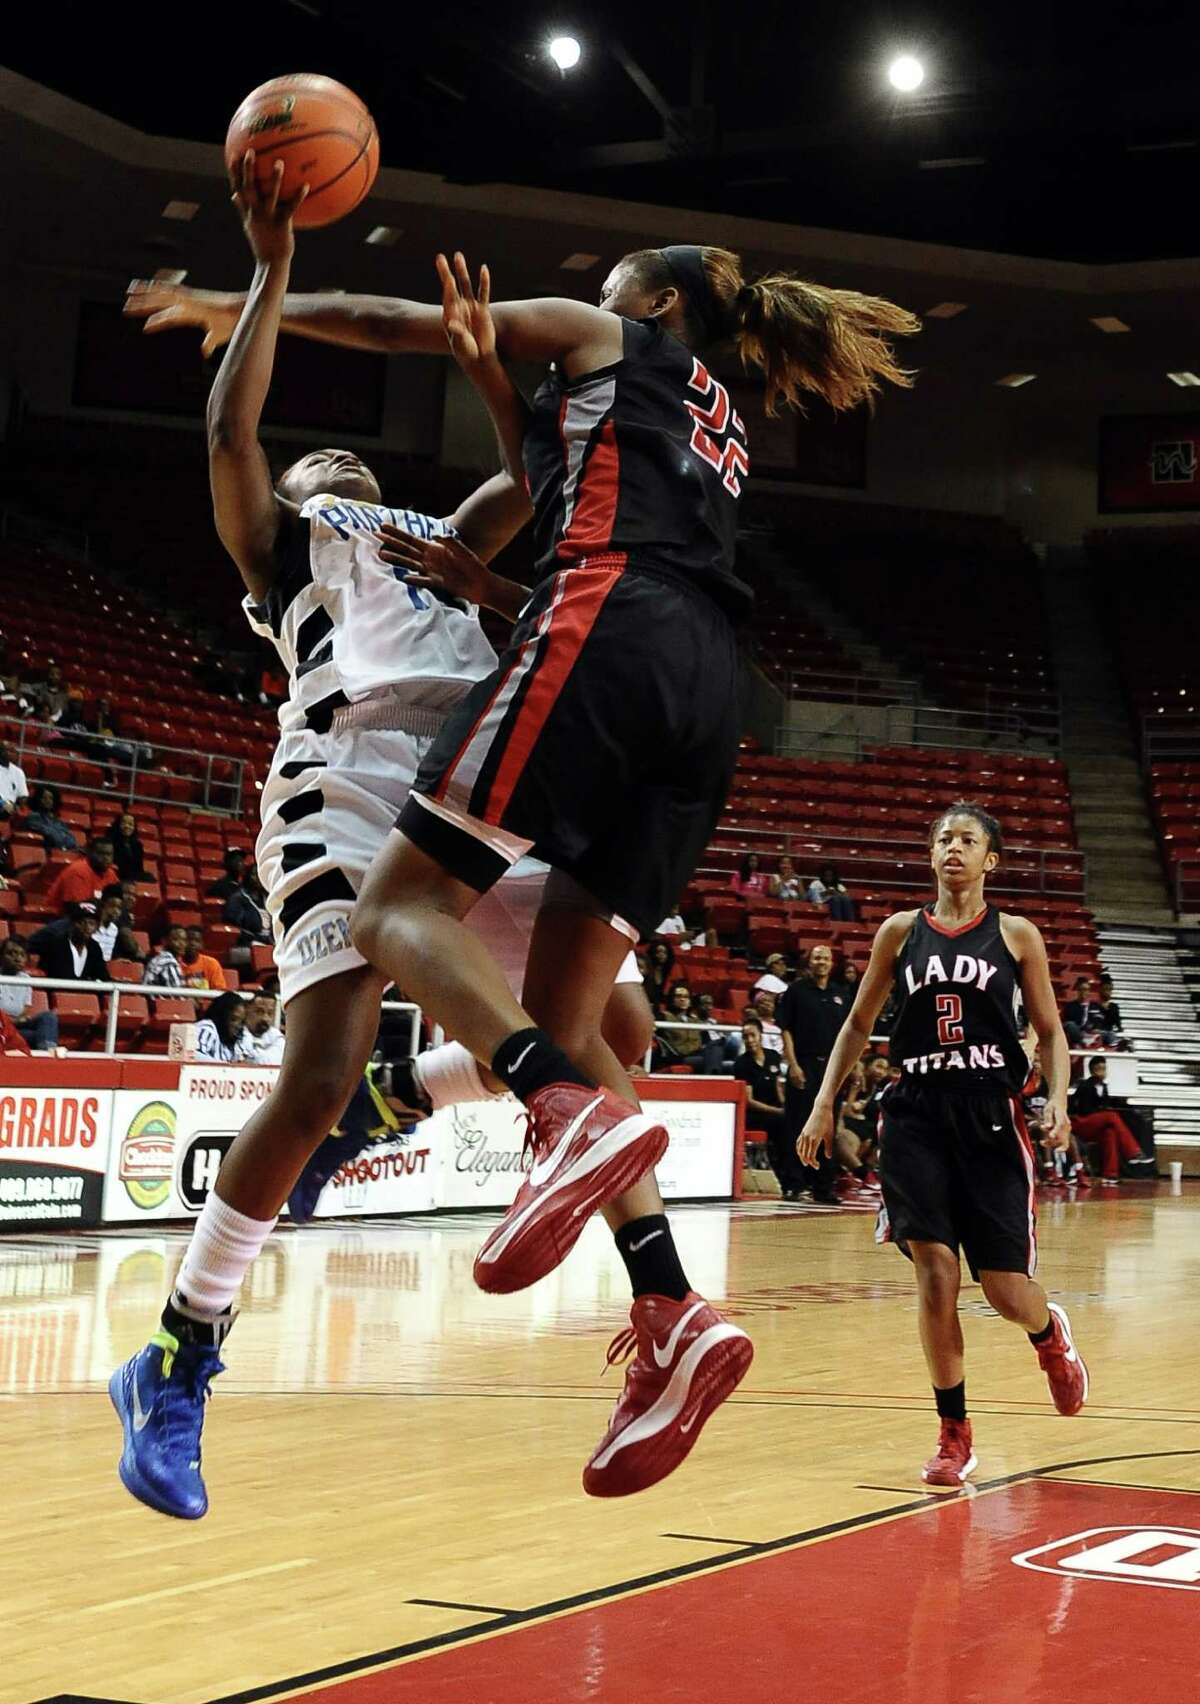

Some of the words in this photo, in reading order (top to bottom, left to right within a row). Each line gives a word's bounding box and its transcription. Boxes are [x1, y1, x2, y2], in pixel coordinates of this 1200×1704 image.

[904, 954, 998, 995] LADY
[936, 994, 965, 1045] 2
[903, 1044, 1005, 1075] TITANS
[190, 1078, 236, 1099] PROUD
[0, 1095, 98, 1149] GRADS
